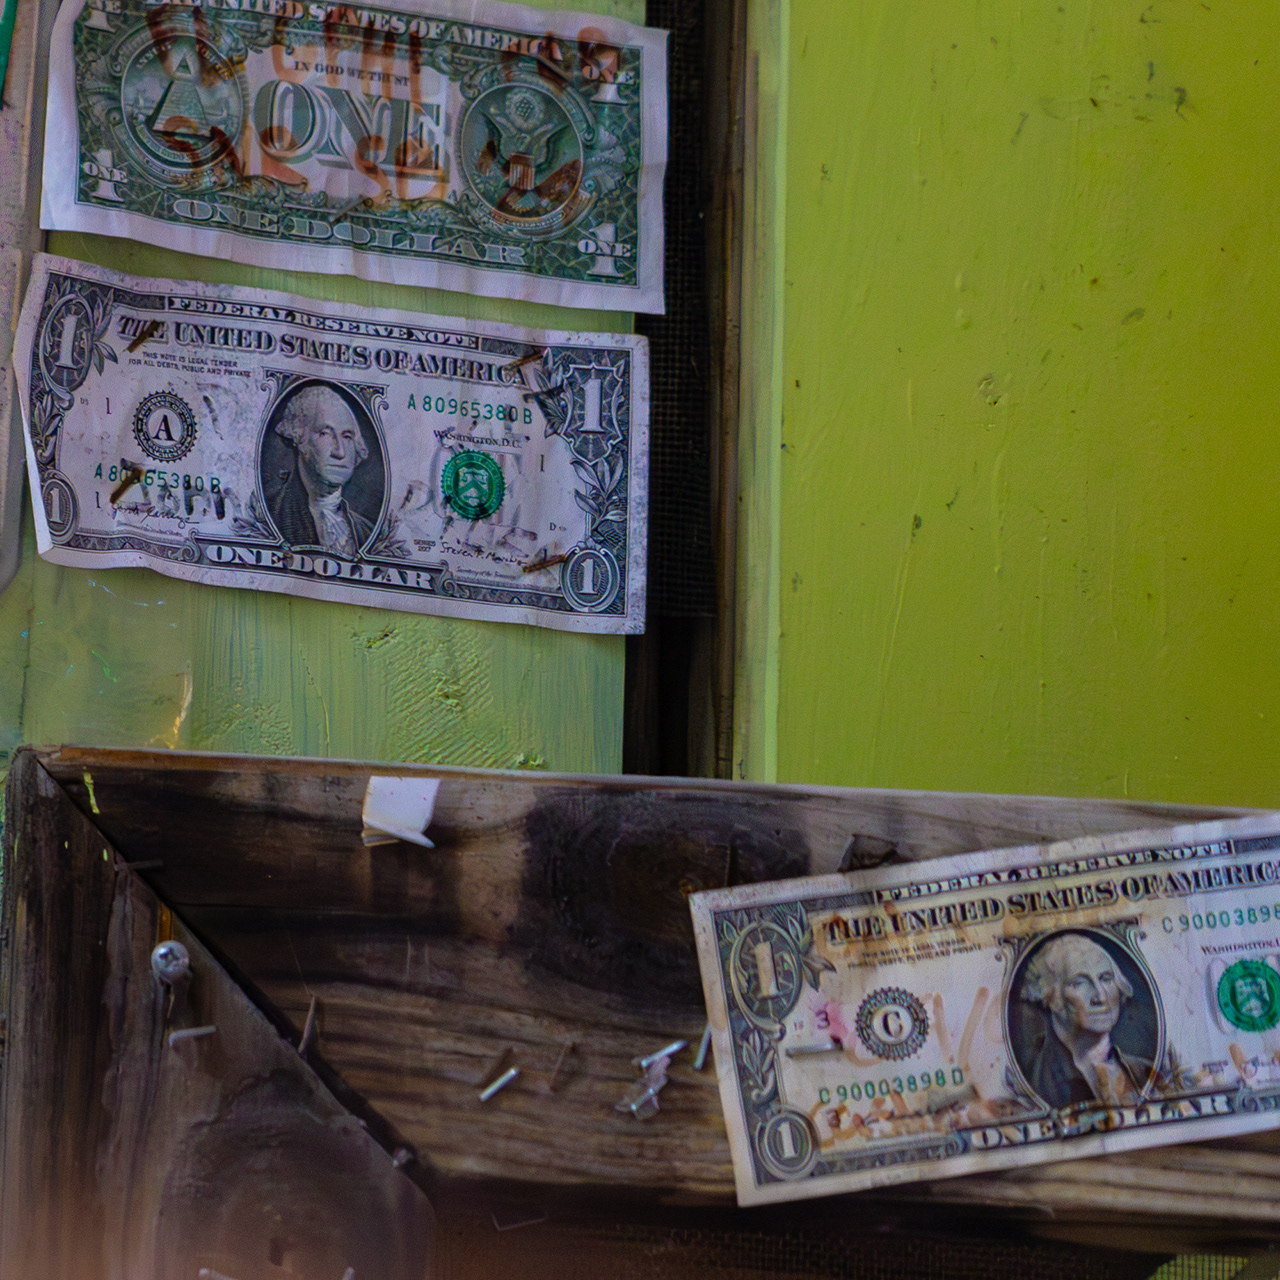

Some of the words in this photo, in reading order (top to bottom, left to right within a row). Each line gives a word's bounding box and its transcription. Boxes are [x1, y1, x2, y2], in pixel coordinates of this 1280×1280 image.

[173, 197, 282, 232] ONE
[283, 217, 527, 266] DOLLAR
[577, 238, 633, 260] ONE
[170, 296, 297, 323] FEDERAL
[297, 309, 407, 340] RESERVE
[408, 327, 480, 349] NOTE
[172, 321, 276, 354] UNITED
[279, 333, 373, 371] STATES
[375, 347, 410, 374] OF
[407, 353, 530, 388] AMERICA
[578, 377, 606, 434] 1
[407, 394, 533, 425] A80965380B
[152, 411, 175, 443] A
[93, 462, 221, 494] A8065380B
[204, 543, 286, 568] ONE
[288, 556, 435, 591] DOLLAR
[579, 559, 600, 595] 1
[1157, 840, 1232, 860] NOTE
[889, 896, 1004, 938] UNITED
[1005, 880, 1118, 915] STATES
[1120, 876, 1160, 901] OF
[1158, 861, 1280, 899] AMERIC
[882, 1010, 903, 1039] C
[818, 1067, 964, 1105] C90003898D
[970, 1121, 1057, 1149] ONE
